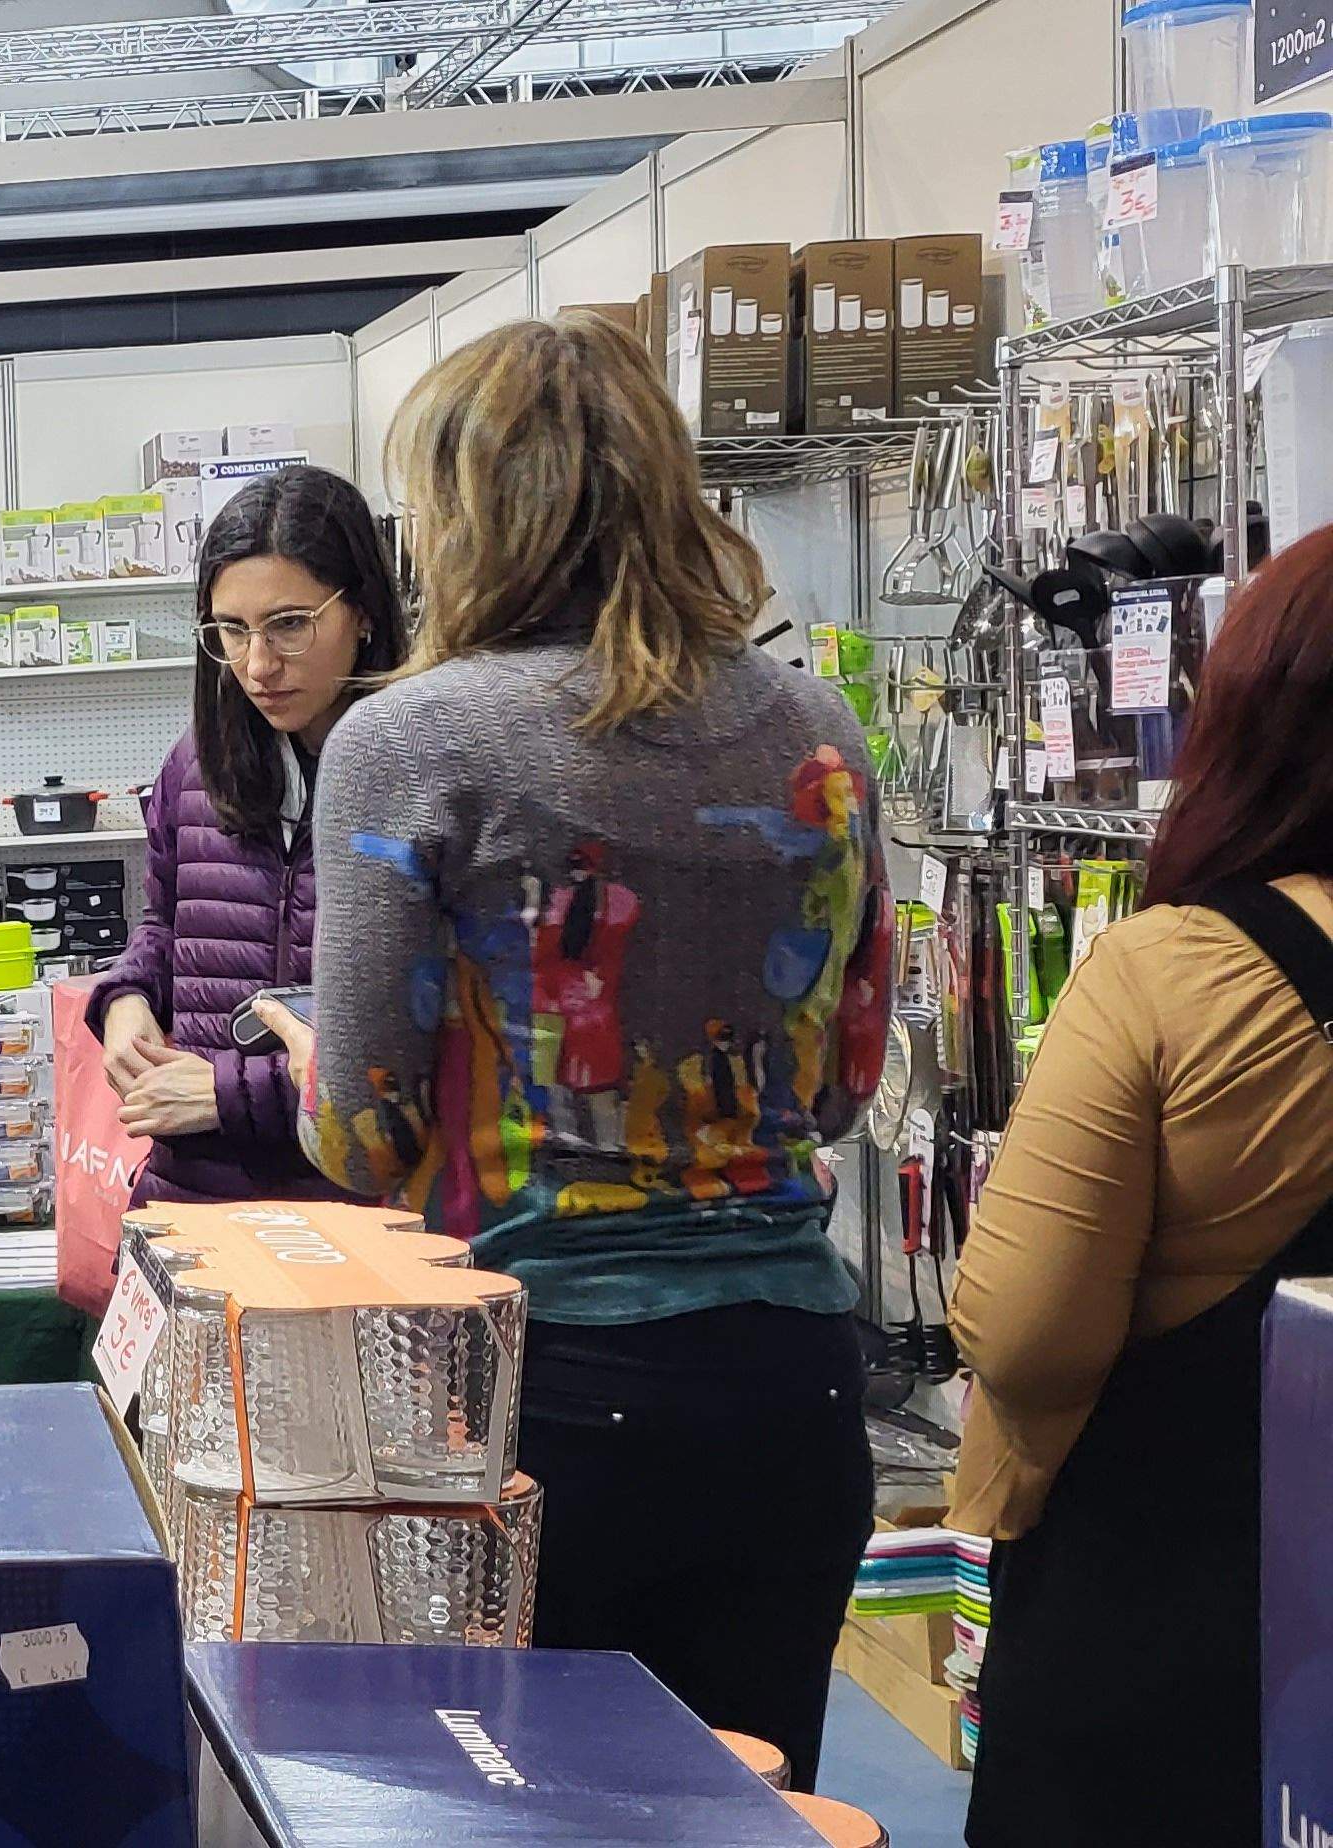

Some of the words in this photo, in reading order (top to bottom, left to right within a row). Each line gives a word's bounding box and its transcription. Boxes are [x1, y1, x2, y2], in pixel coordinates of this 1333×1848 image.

[220, 461, 279, 476] COMERCIAL
[254, 1229, 347, 1264] QUID
[121, 1269, 138, 1297] 6
[434, 1708, 526, 1787] Luminarc
